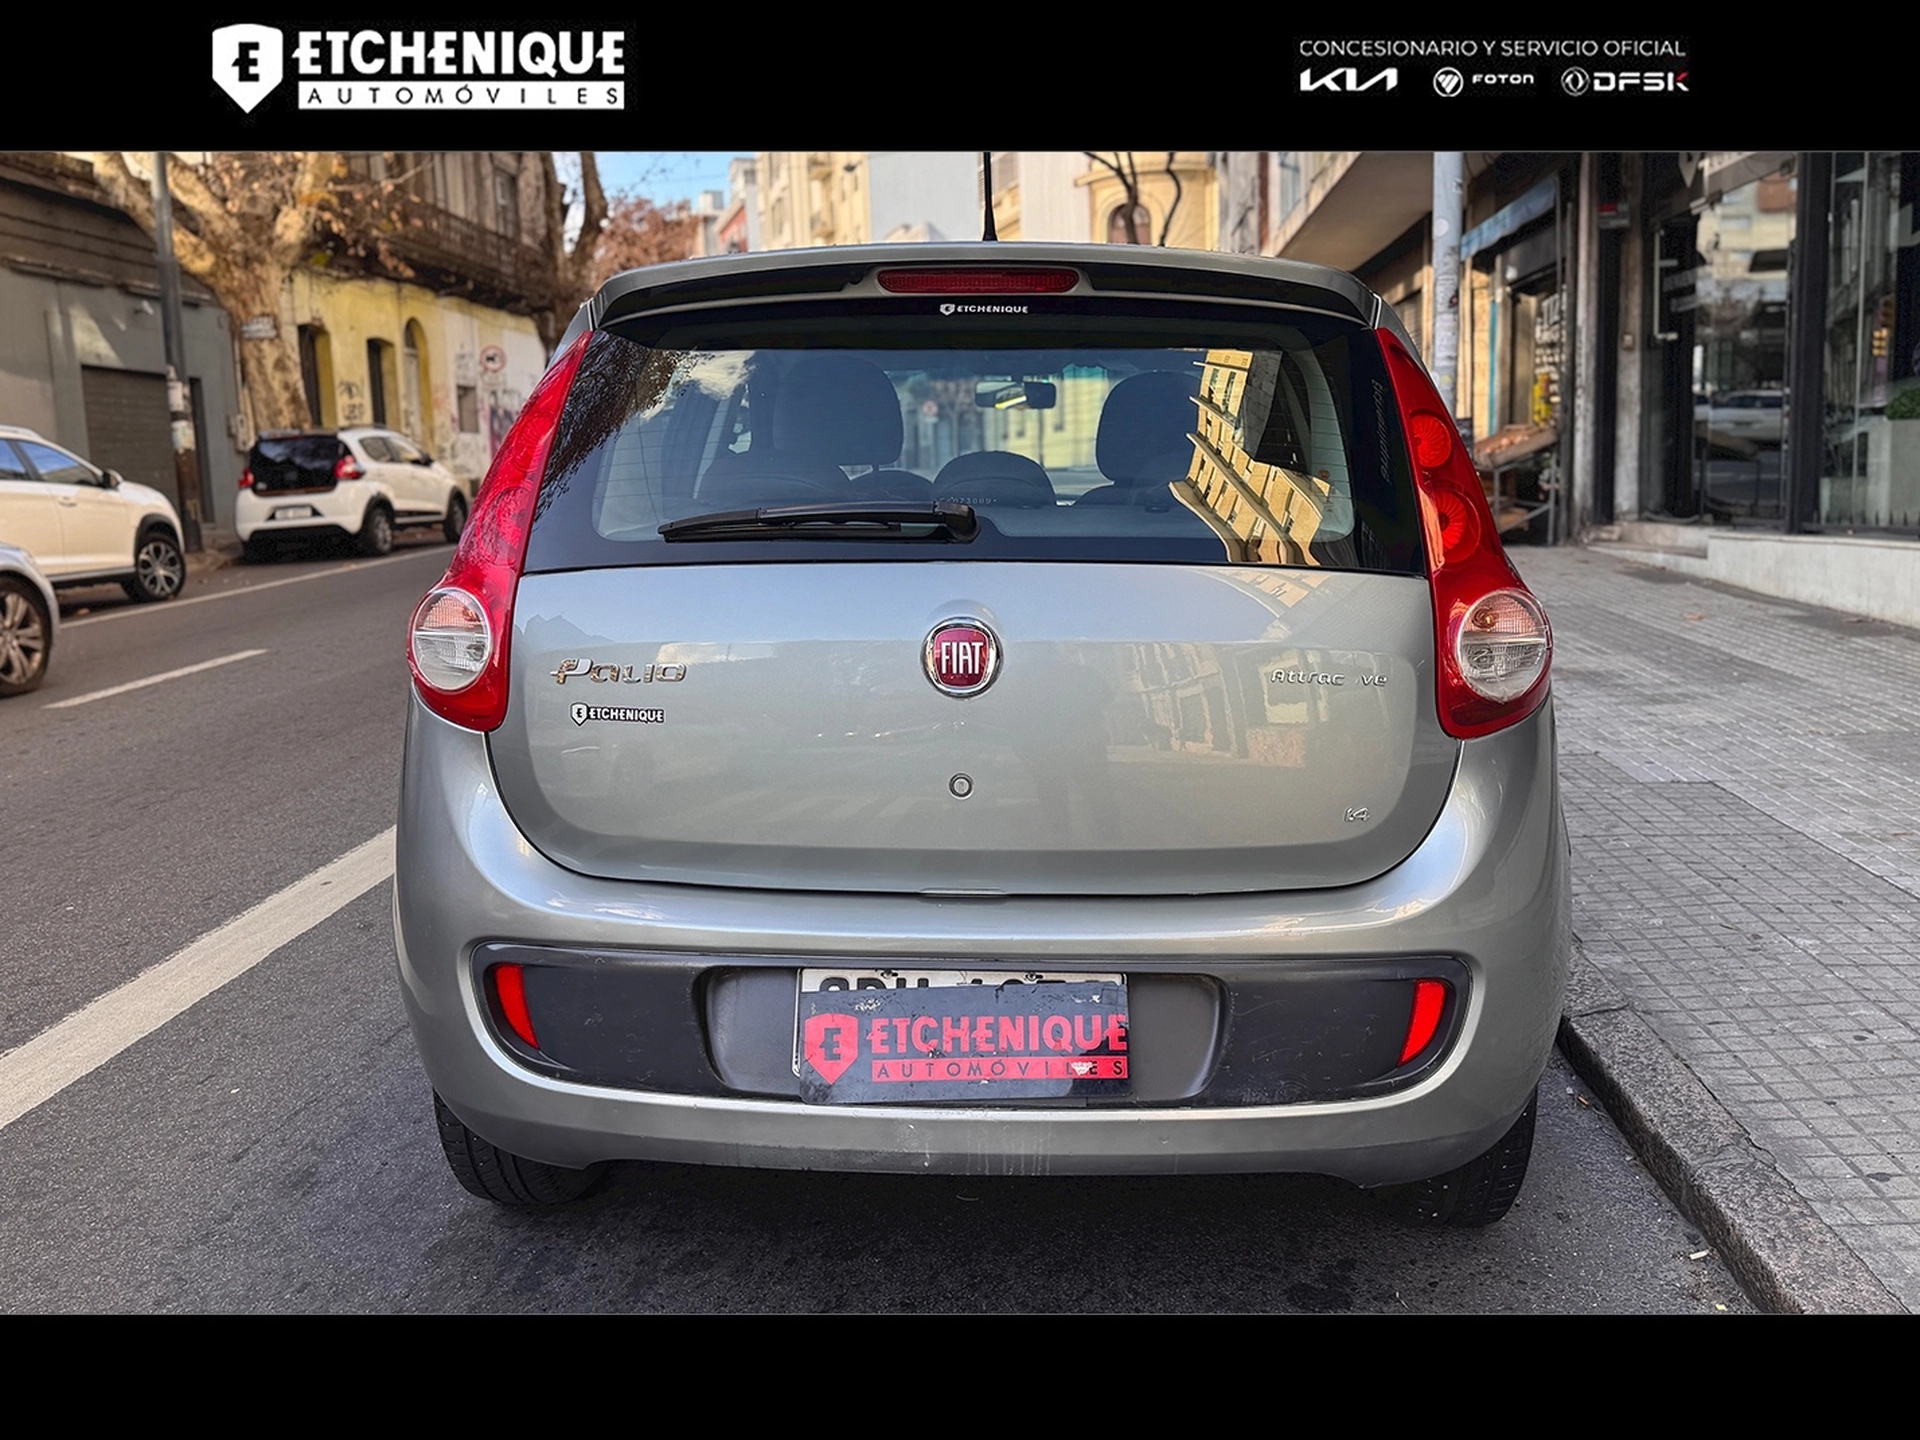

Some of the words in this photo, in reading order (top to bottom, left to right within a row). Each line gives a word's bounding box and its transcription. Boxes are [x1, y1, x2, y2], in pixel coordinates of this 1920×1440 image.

[956, 304, 1029, 315] ETCHENIQUE
[940, 641, 984, 675] FIAT
[588, 707, 664, 725] ETCHENIQUE
[866, 1014, 1128, 1054] ETCHENIQUE
